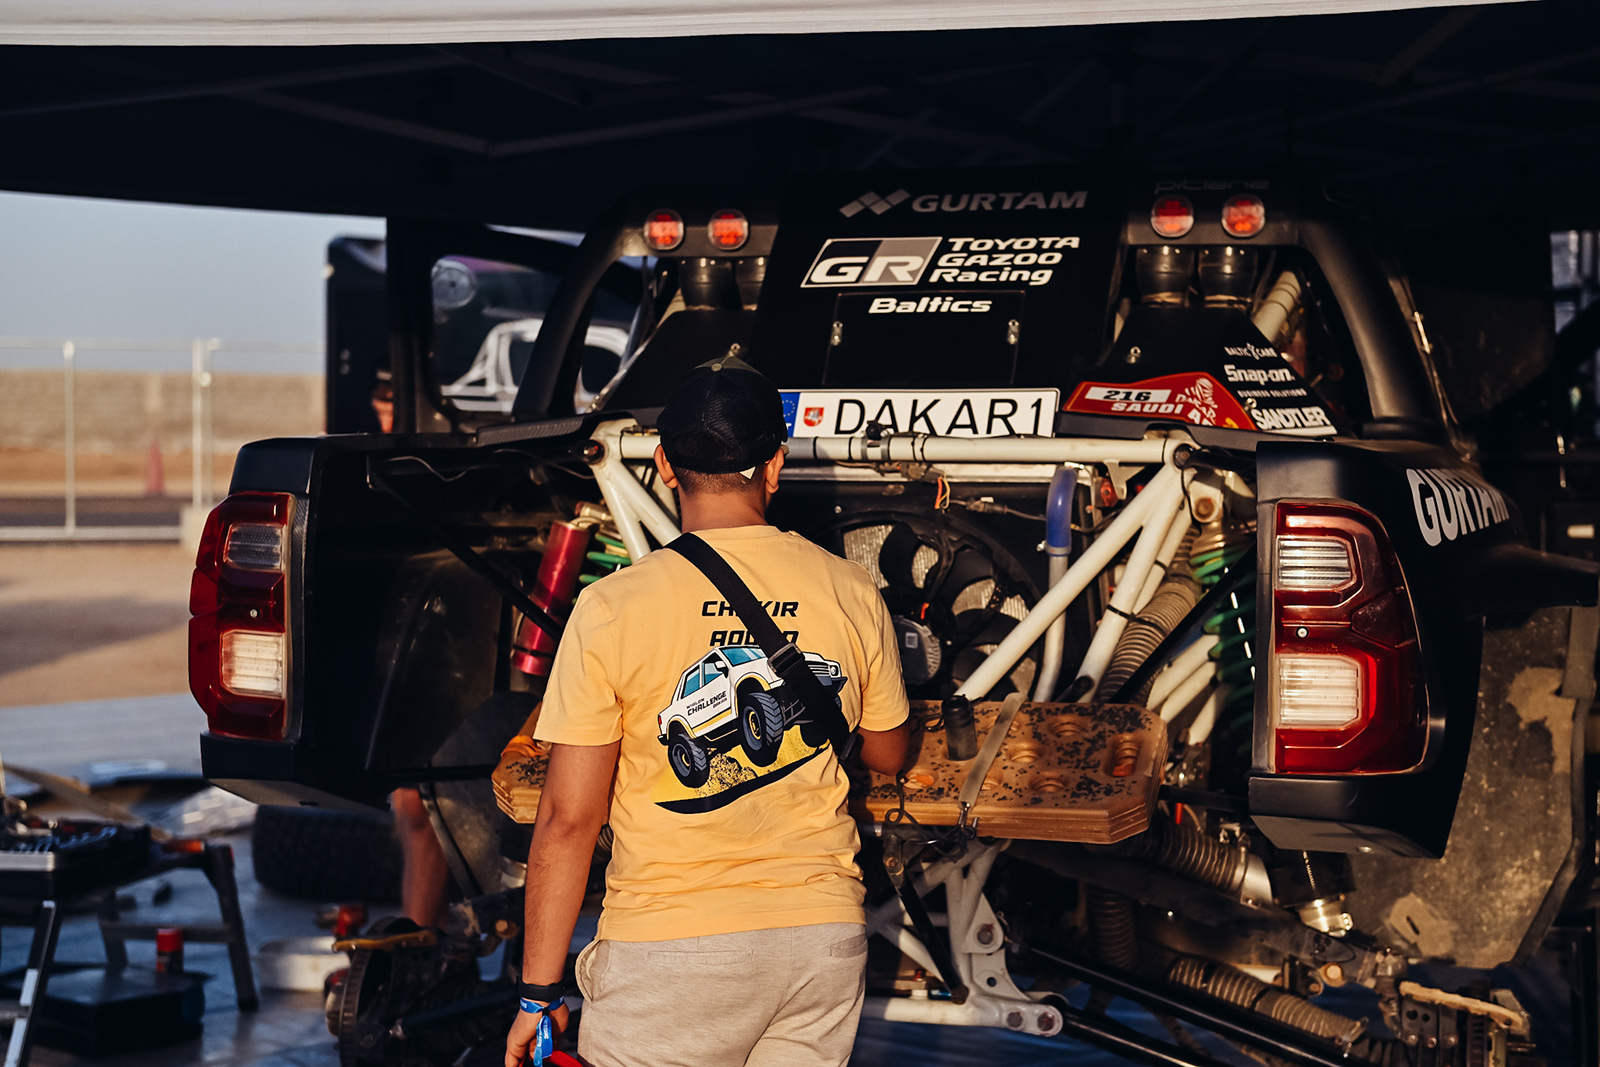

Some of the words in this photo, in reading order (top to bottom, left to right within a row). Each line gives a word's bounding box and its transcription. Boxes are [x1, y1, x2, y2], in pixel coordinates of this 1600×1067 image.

[912, 191, 1088, 213] GURTAM
[948, 237, 1080, 251] TOYOTA
[809, 255, 924, 284] GR
[937, 252, 1063, 267] GAZOO
[929, 267, 1053, 286] Racing
[868, 296, 993, 314] Baltics
[1103, 390, 1152, 402] 216
[834, 398, 1043, 436] DAKAR1
[1111, 402, 1184, 414] SAUDI
[1250, 406, 1332, 430] SANDTLER
[1405, 468, 1510, 547] GURTAM
[687, 690, 728, 716] CHALLENGE
